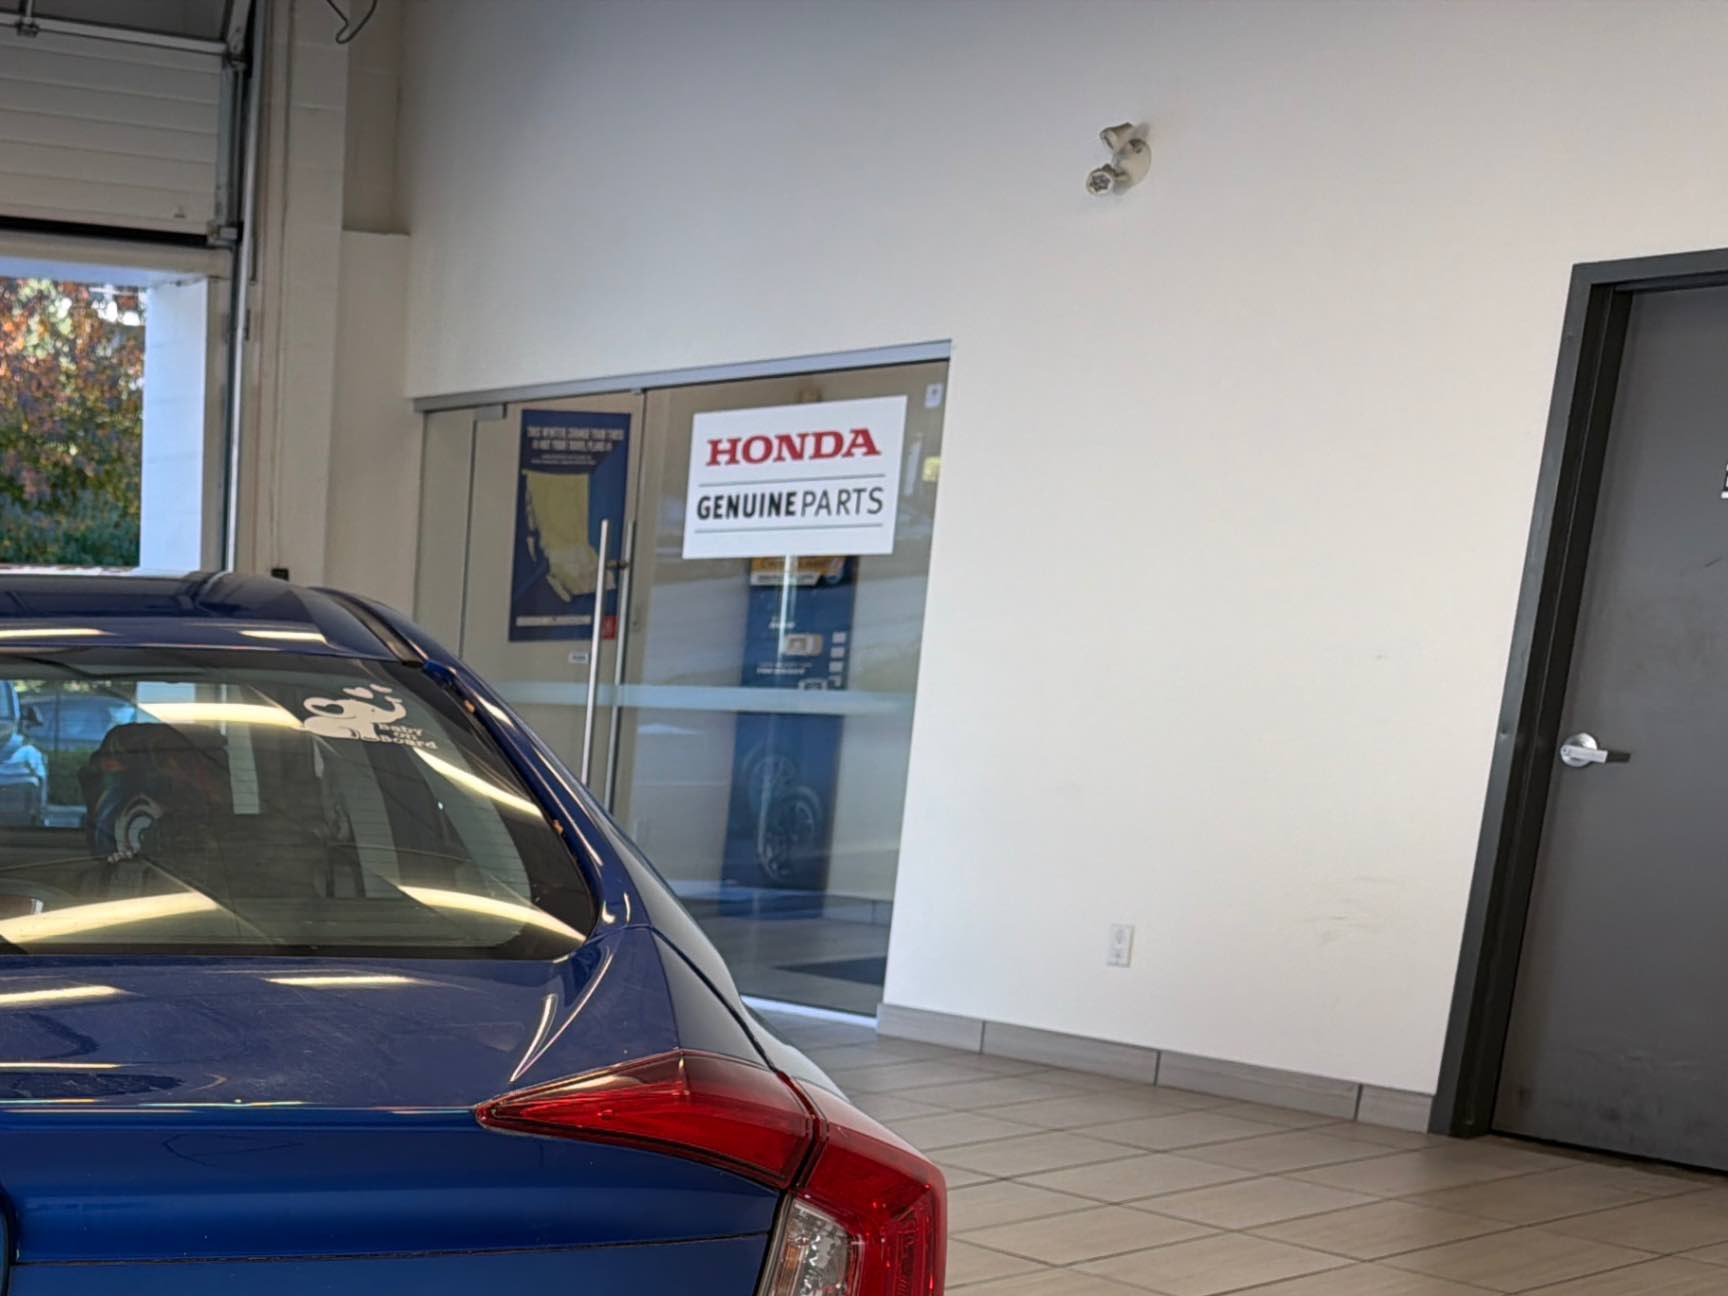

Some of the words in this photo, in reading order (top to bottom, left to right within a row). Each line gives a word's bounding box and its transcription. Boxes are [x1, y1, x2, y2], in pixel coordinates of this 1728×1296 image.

[705, 427, 881, 466] HONDA
[697, 490, 797, 519] GENUINE
[801, 486, 884, 517] PARTS
